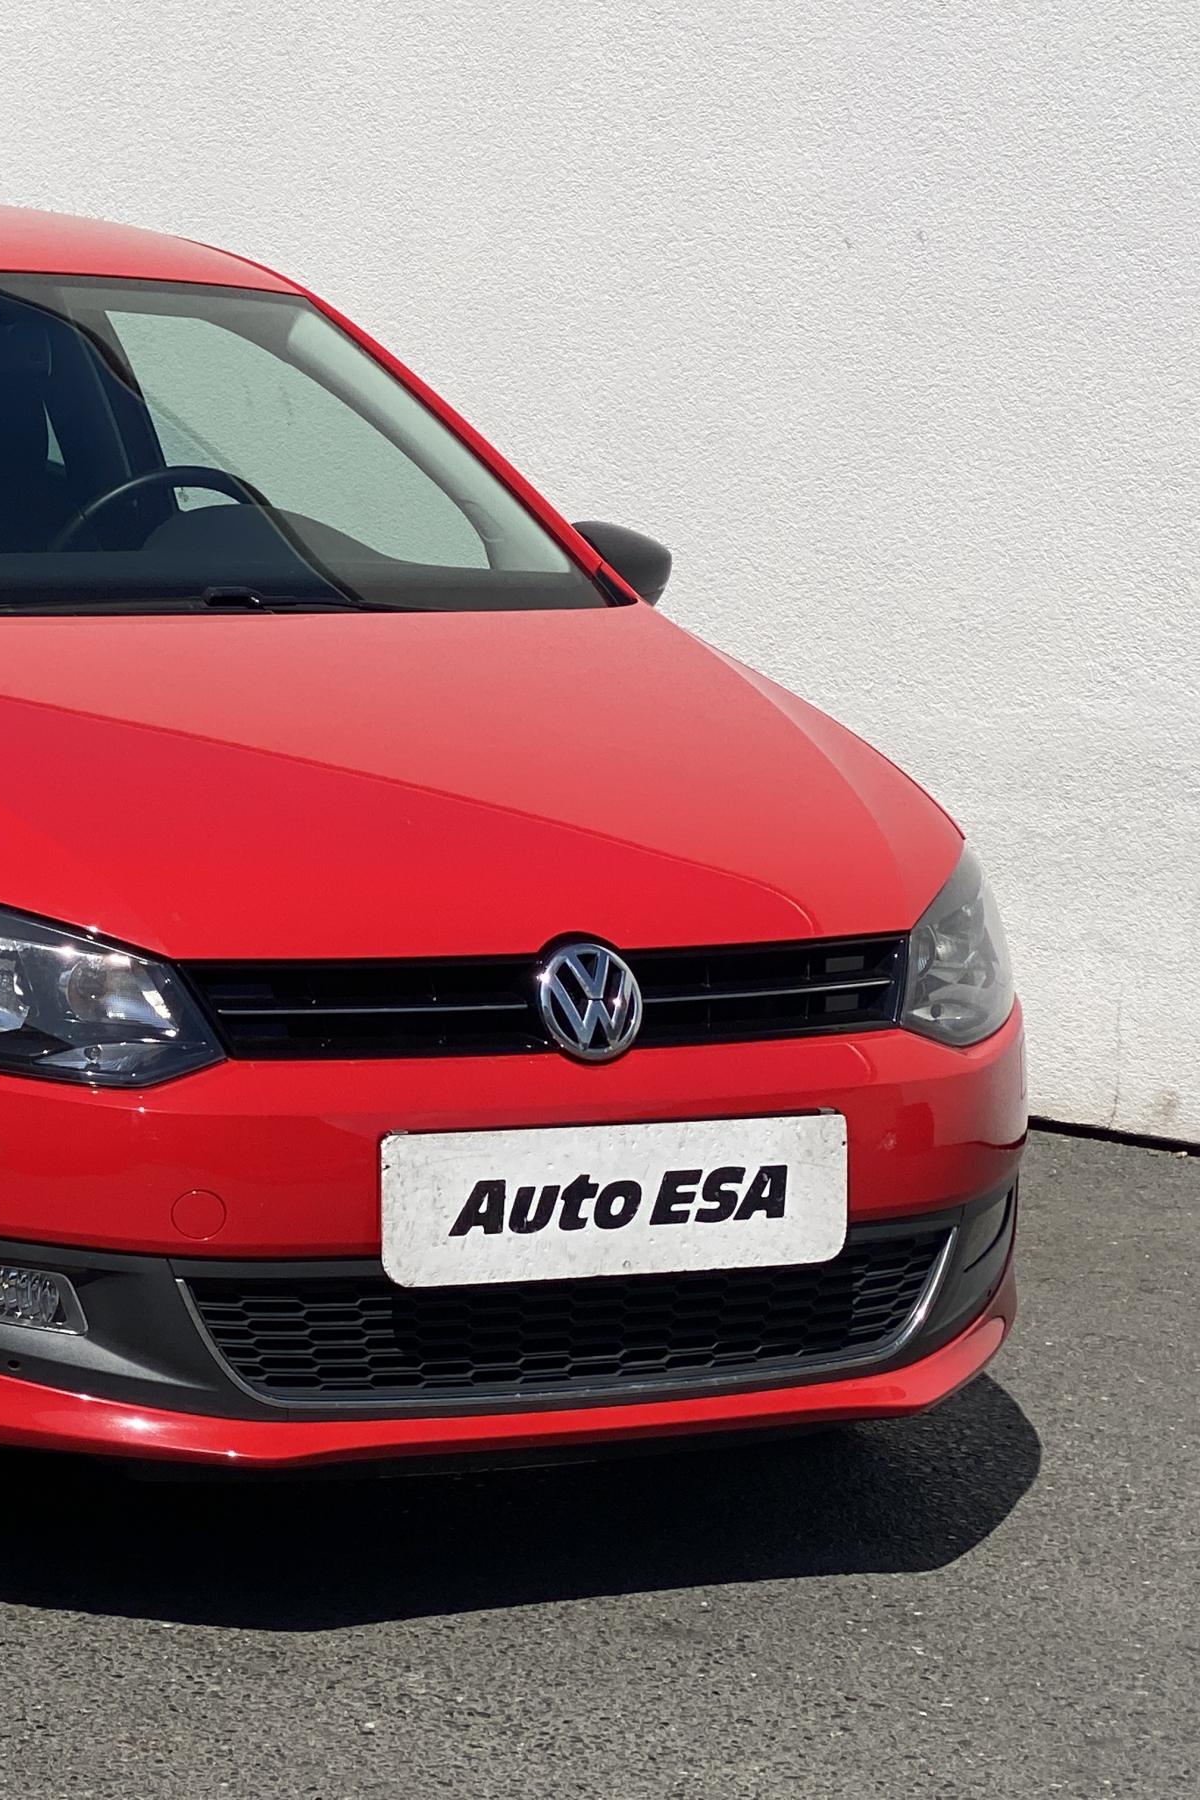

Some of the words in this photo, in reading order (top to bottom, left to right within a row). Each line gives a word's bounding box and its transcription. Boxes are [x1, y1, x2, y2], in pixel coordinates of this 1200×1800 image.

[542, 945, 641, 1058] VW
[448, 1174, 643, 1237] Auto
[649, 1164, 788, 1226] ESA
